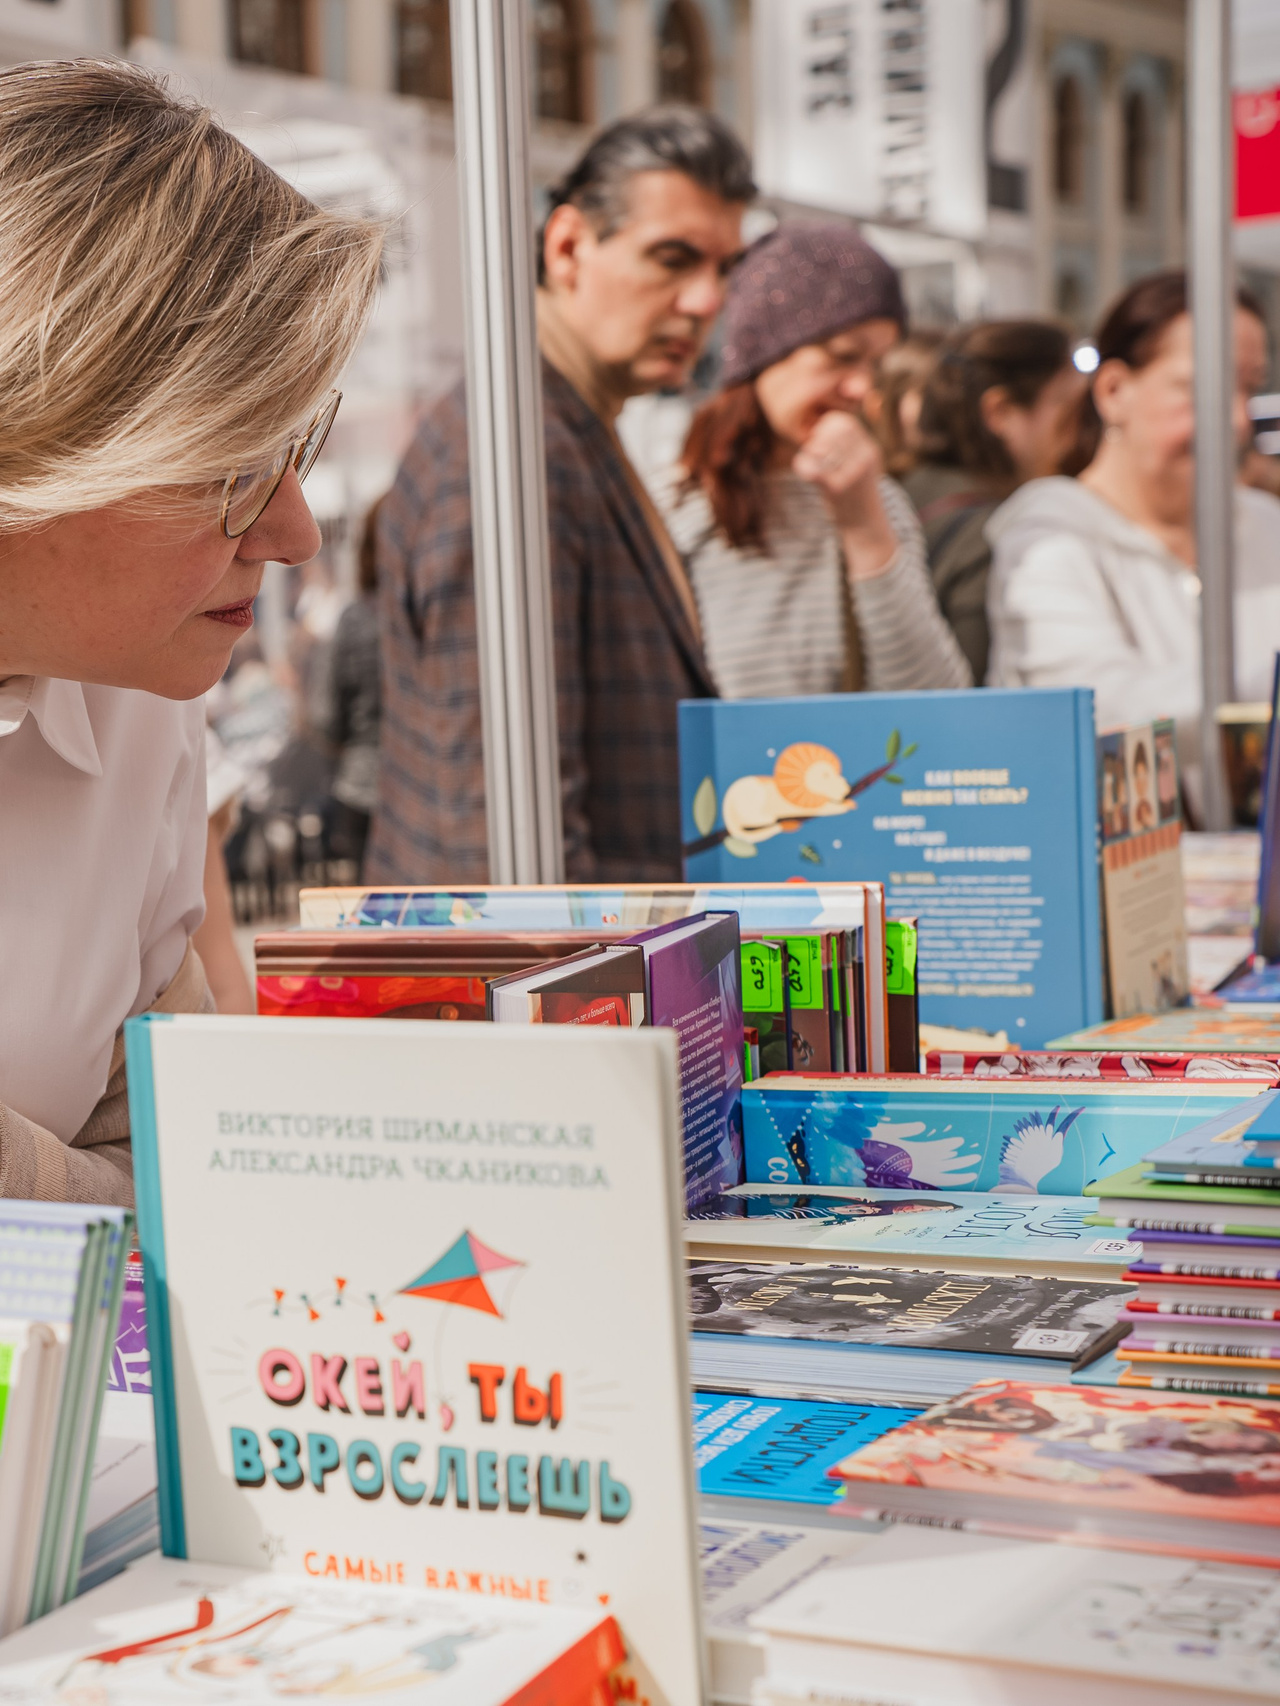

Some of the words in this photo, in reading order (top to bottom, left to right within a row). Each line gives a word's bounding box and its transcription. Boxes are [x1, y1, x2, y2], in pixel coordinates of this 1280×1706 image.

[750, 956, 764, 990] 650
[217, 1110, 373, 1141] ВИКТОРИЯ
[382, 1117, 594, 1150] ШИМАНСКАЯ
[208, 1148, 403, 1181] АЛЕКСАНДРА
[413, 1157, 610, 1190] ЧКАНИКОВА
[943, 1201, 1038, 1239] ЛОЛА
[1024, 1207, 1098, 1240] МОЯ
[728, 1283, 798, 1311] АКУЛА
[886, 1281, 991, 1329] ДЖУЛИЯ
[468, 1363, 563, 1429] ТЫ
[722, 1409, 871, 1485] ПОДРОСТКИ
[229, 1425, 633, 1524] ВЗРОСЛЕЕШЬ
[304, 1551, 406, 1585] САМЫЕ
[425, 1567, 551, 1604] ВАЖНЫЕ
